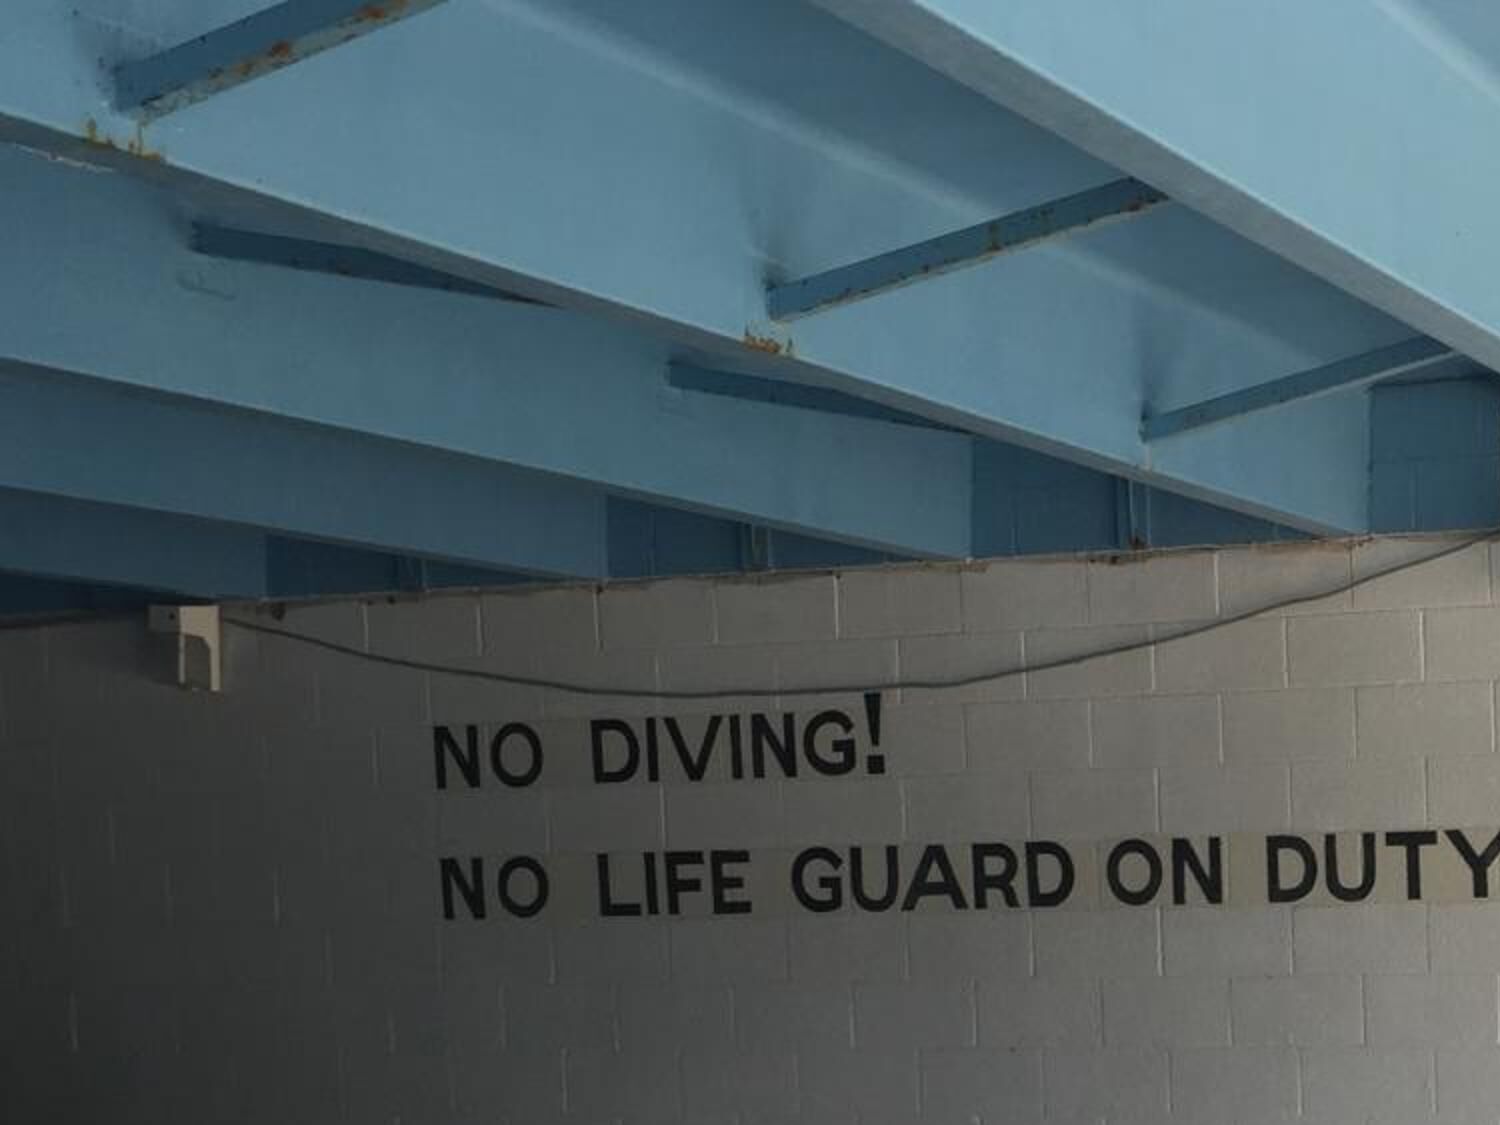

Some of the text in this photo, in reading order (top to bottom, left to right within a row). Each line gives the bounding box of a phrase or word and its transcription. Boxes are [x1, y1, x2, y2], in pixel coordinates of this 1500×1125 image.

[433, 690, 886, 789] NO DIVING!
[438, 856, 550, 920] NO
[596, 849, 752, 917] LIFE
[790, 841, 1075, 914] GUARD
[1107, 836, 1223, 906] ON
